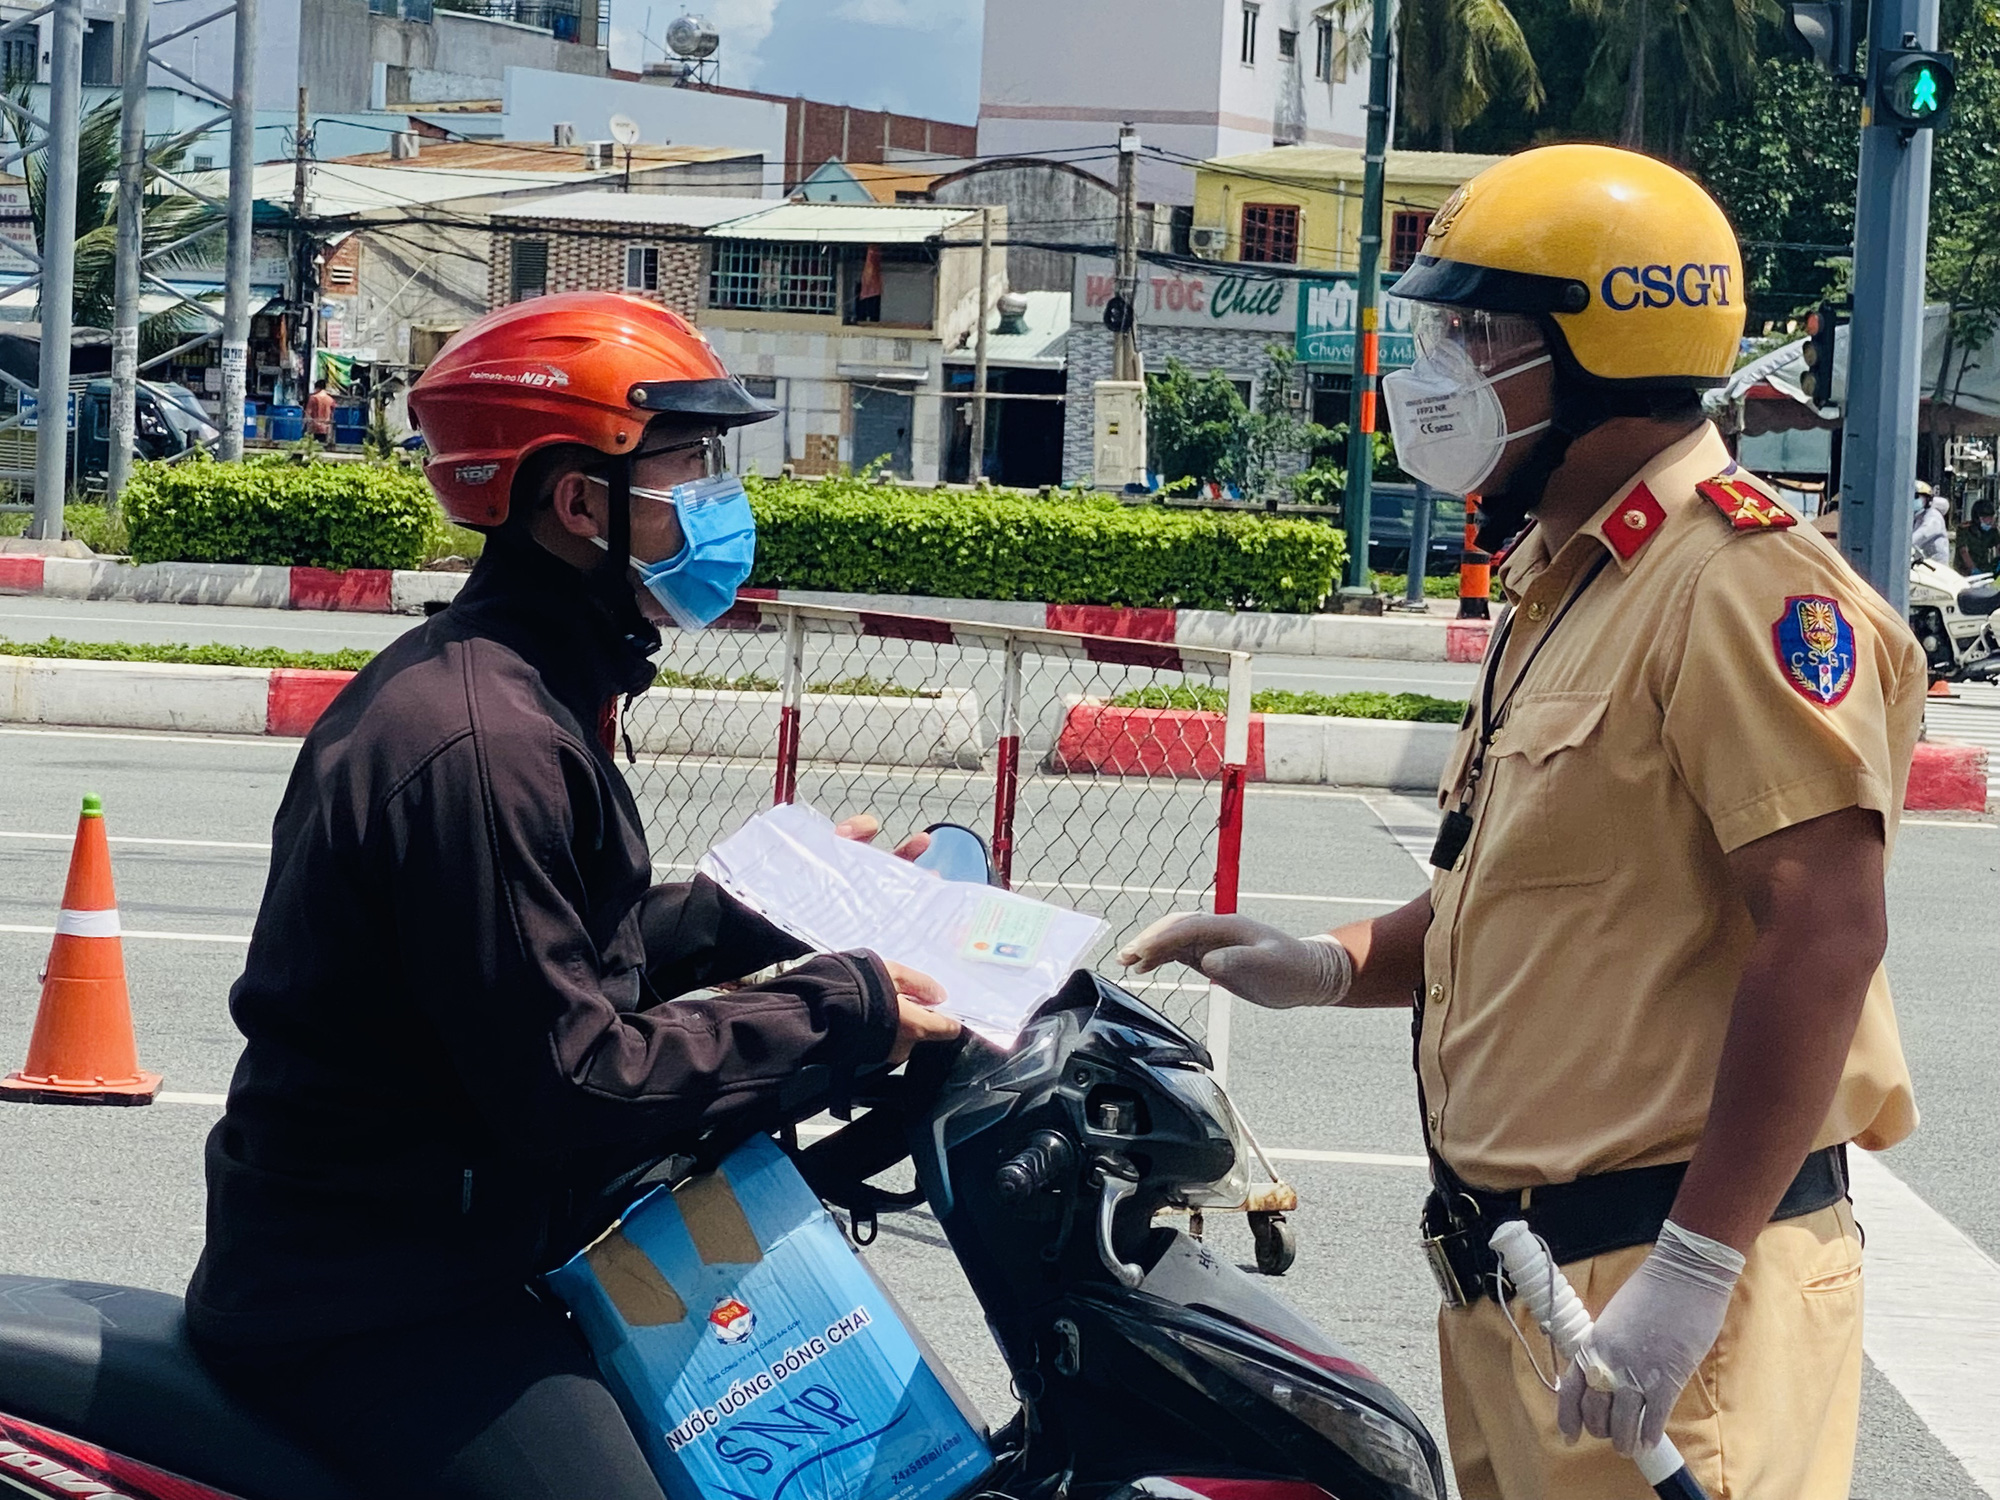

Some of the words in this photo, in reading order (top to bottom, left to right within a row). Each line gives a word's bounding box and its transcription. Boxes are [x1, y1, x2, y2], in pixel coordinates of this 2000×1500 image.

[1601, 263, 1731, 311] CSGT
[520, 372, 557, 387] NBT
[1416, 406, 1434, 416] FFP2
[1434, 404, 1447, 414] NR
[1791, 651, 1849, 668] CSGT
[666, 1409, 718, 1451] NƯỚC
[718, 1374, 772, 1415] UỐNG
[773, 1338, 827, 1380] ĐÓNG
[827, 1307, 871, 1343] CHAI
[716, 1384, 859, 1475] SNP
